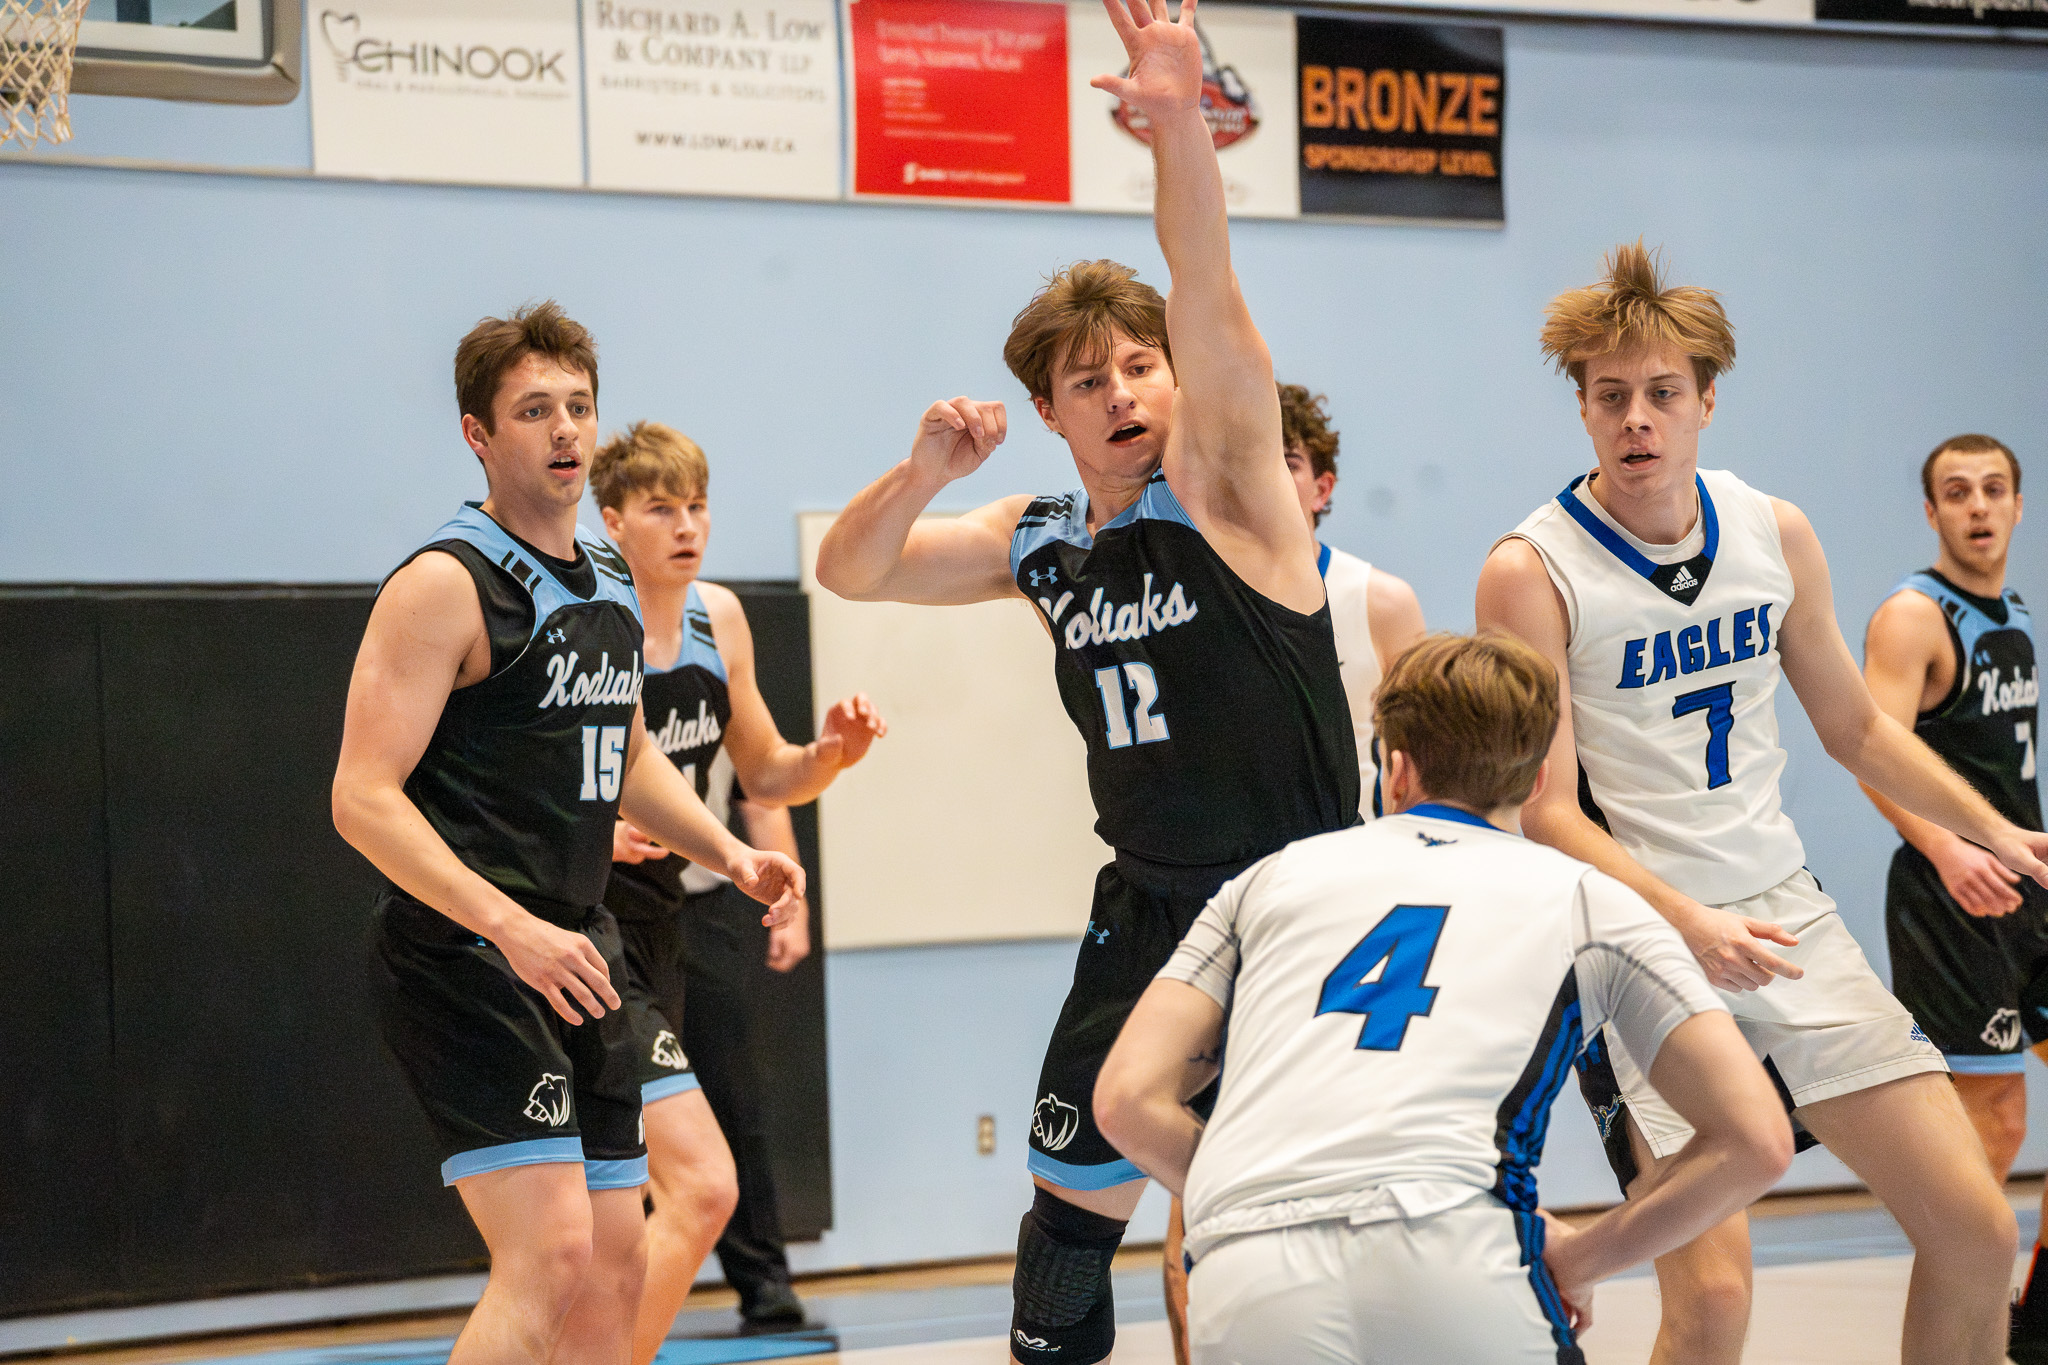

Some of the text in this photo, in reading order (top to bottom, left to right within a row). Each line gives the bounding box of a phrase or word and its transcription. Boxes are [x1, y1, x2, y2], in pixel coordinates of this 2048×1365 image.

[353, 39, 566, 84] CHINOOK
[613, 38, 631, 62] &
[640, 36, 772, 71] COMPANY
[1302, 64, 1500, 137] BRONZE
[1670, 578, 1698, 592] adidas
[1615, 602, 1773, 689] EAGLES
[644, 699, 722, 755] odiaks
[1094, 661, 1171, 750] 12
[1672, 680, 1737, 791] 7
[579, 725, 627, 803] 15
[1313, 904, 1452, 1052] 4
